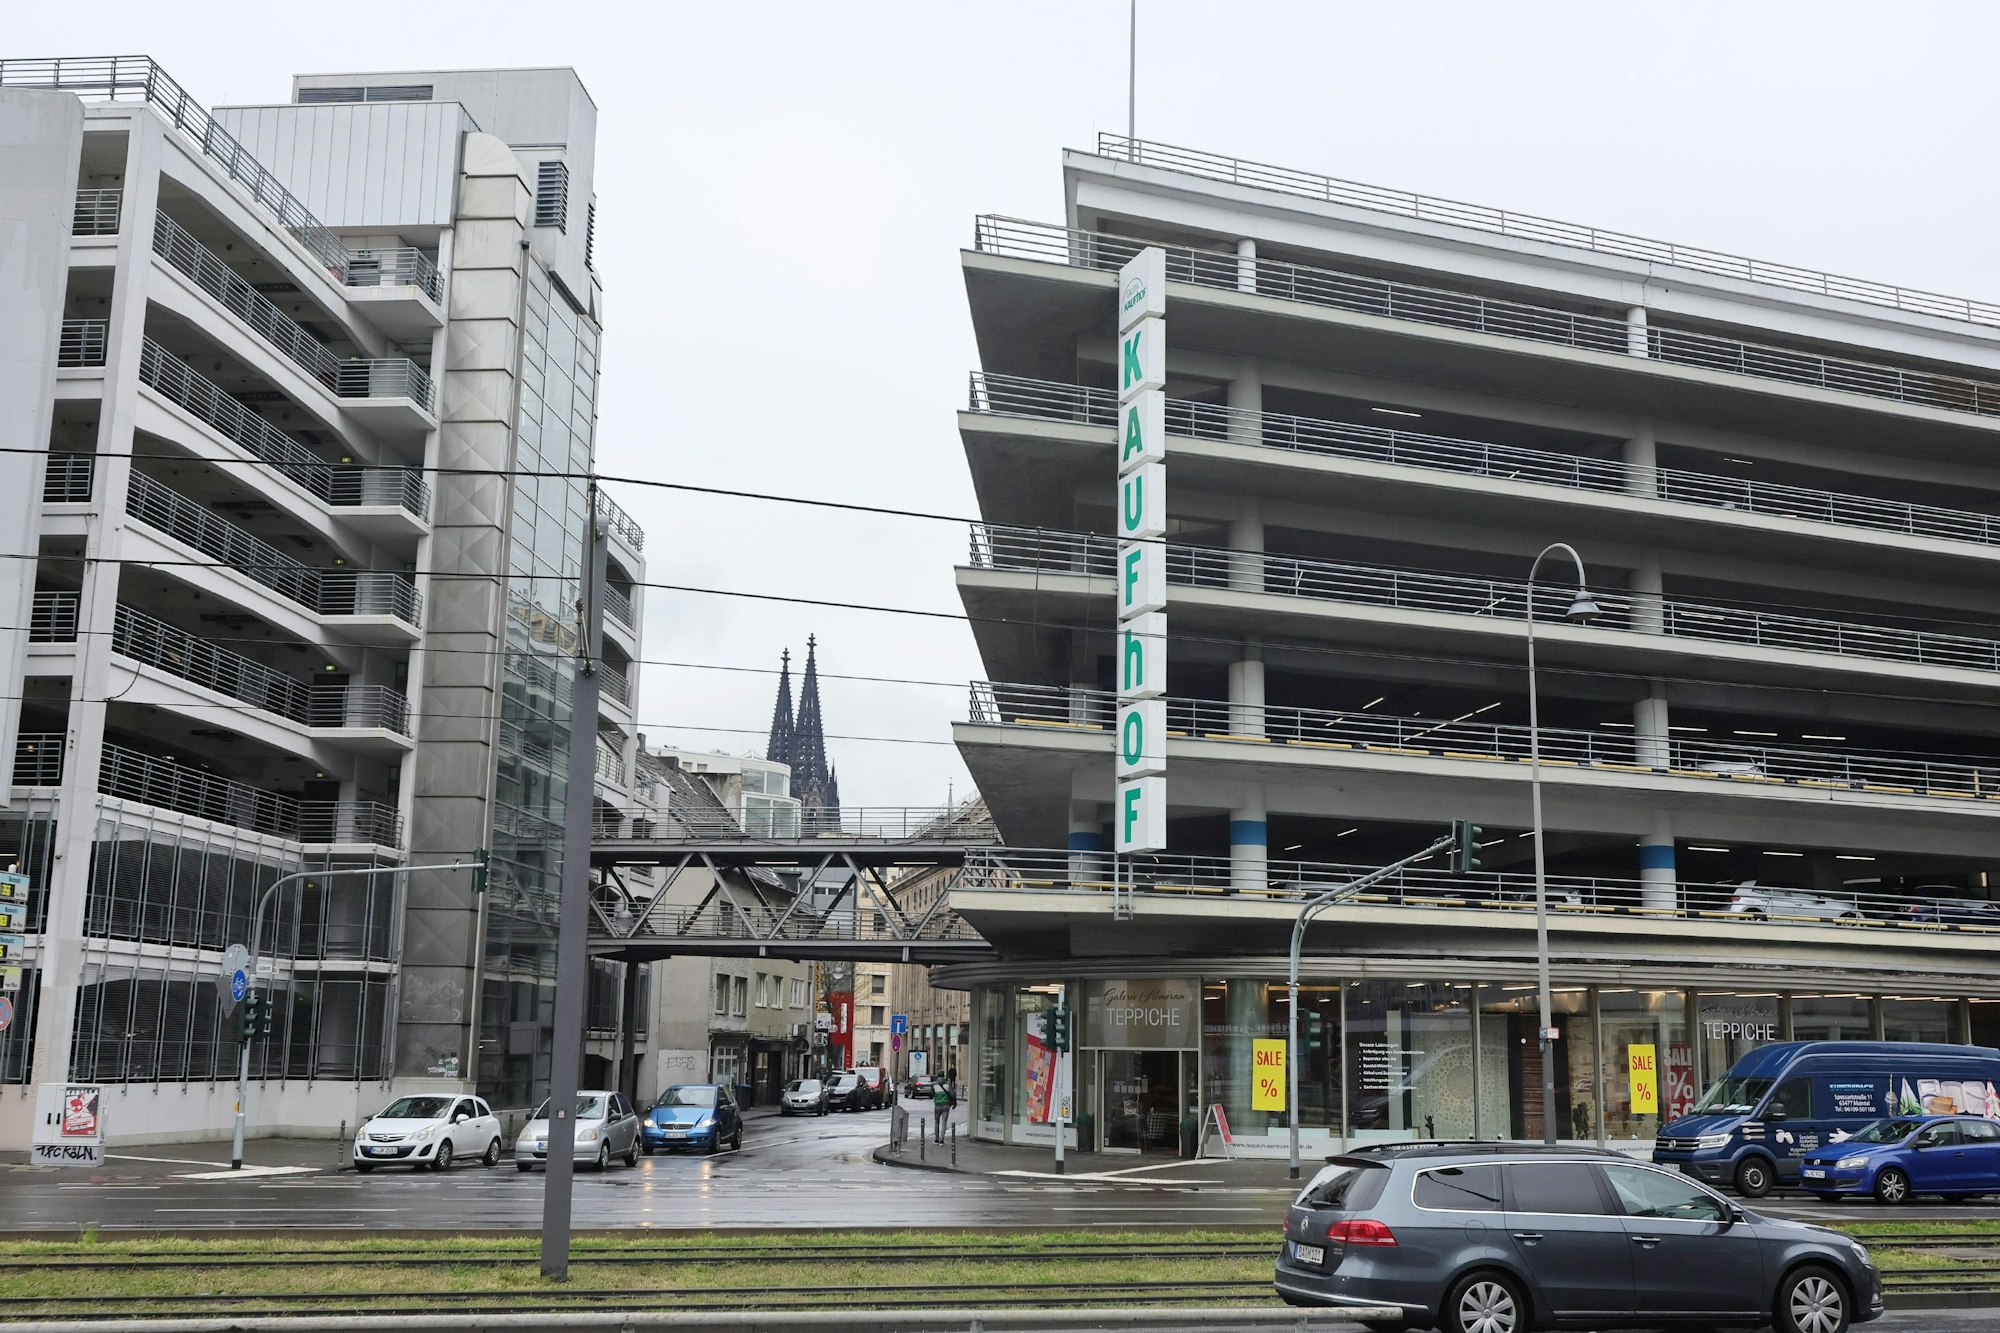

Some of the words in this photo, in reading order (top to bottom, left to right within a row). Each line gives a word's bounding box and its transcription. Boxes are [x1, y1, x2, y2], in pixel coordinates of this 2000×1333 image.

[1106, 1007, 1180, 1026] TEPPICHE
[1703, 1022, 1775, 1041] TEPPICHE
[1256, 1050, 1282, 1066] SALE
[1632, 1055, 1653, 1071] SALE
[1261, 1079, 1278, 1098] %
[1637, 1082, 1651, 1100] %
[1667, 1071, 1694, 1100] %
